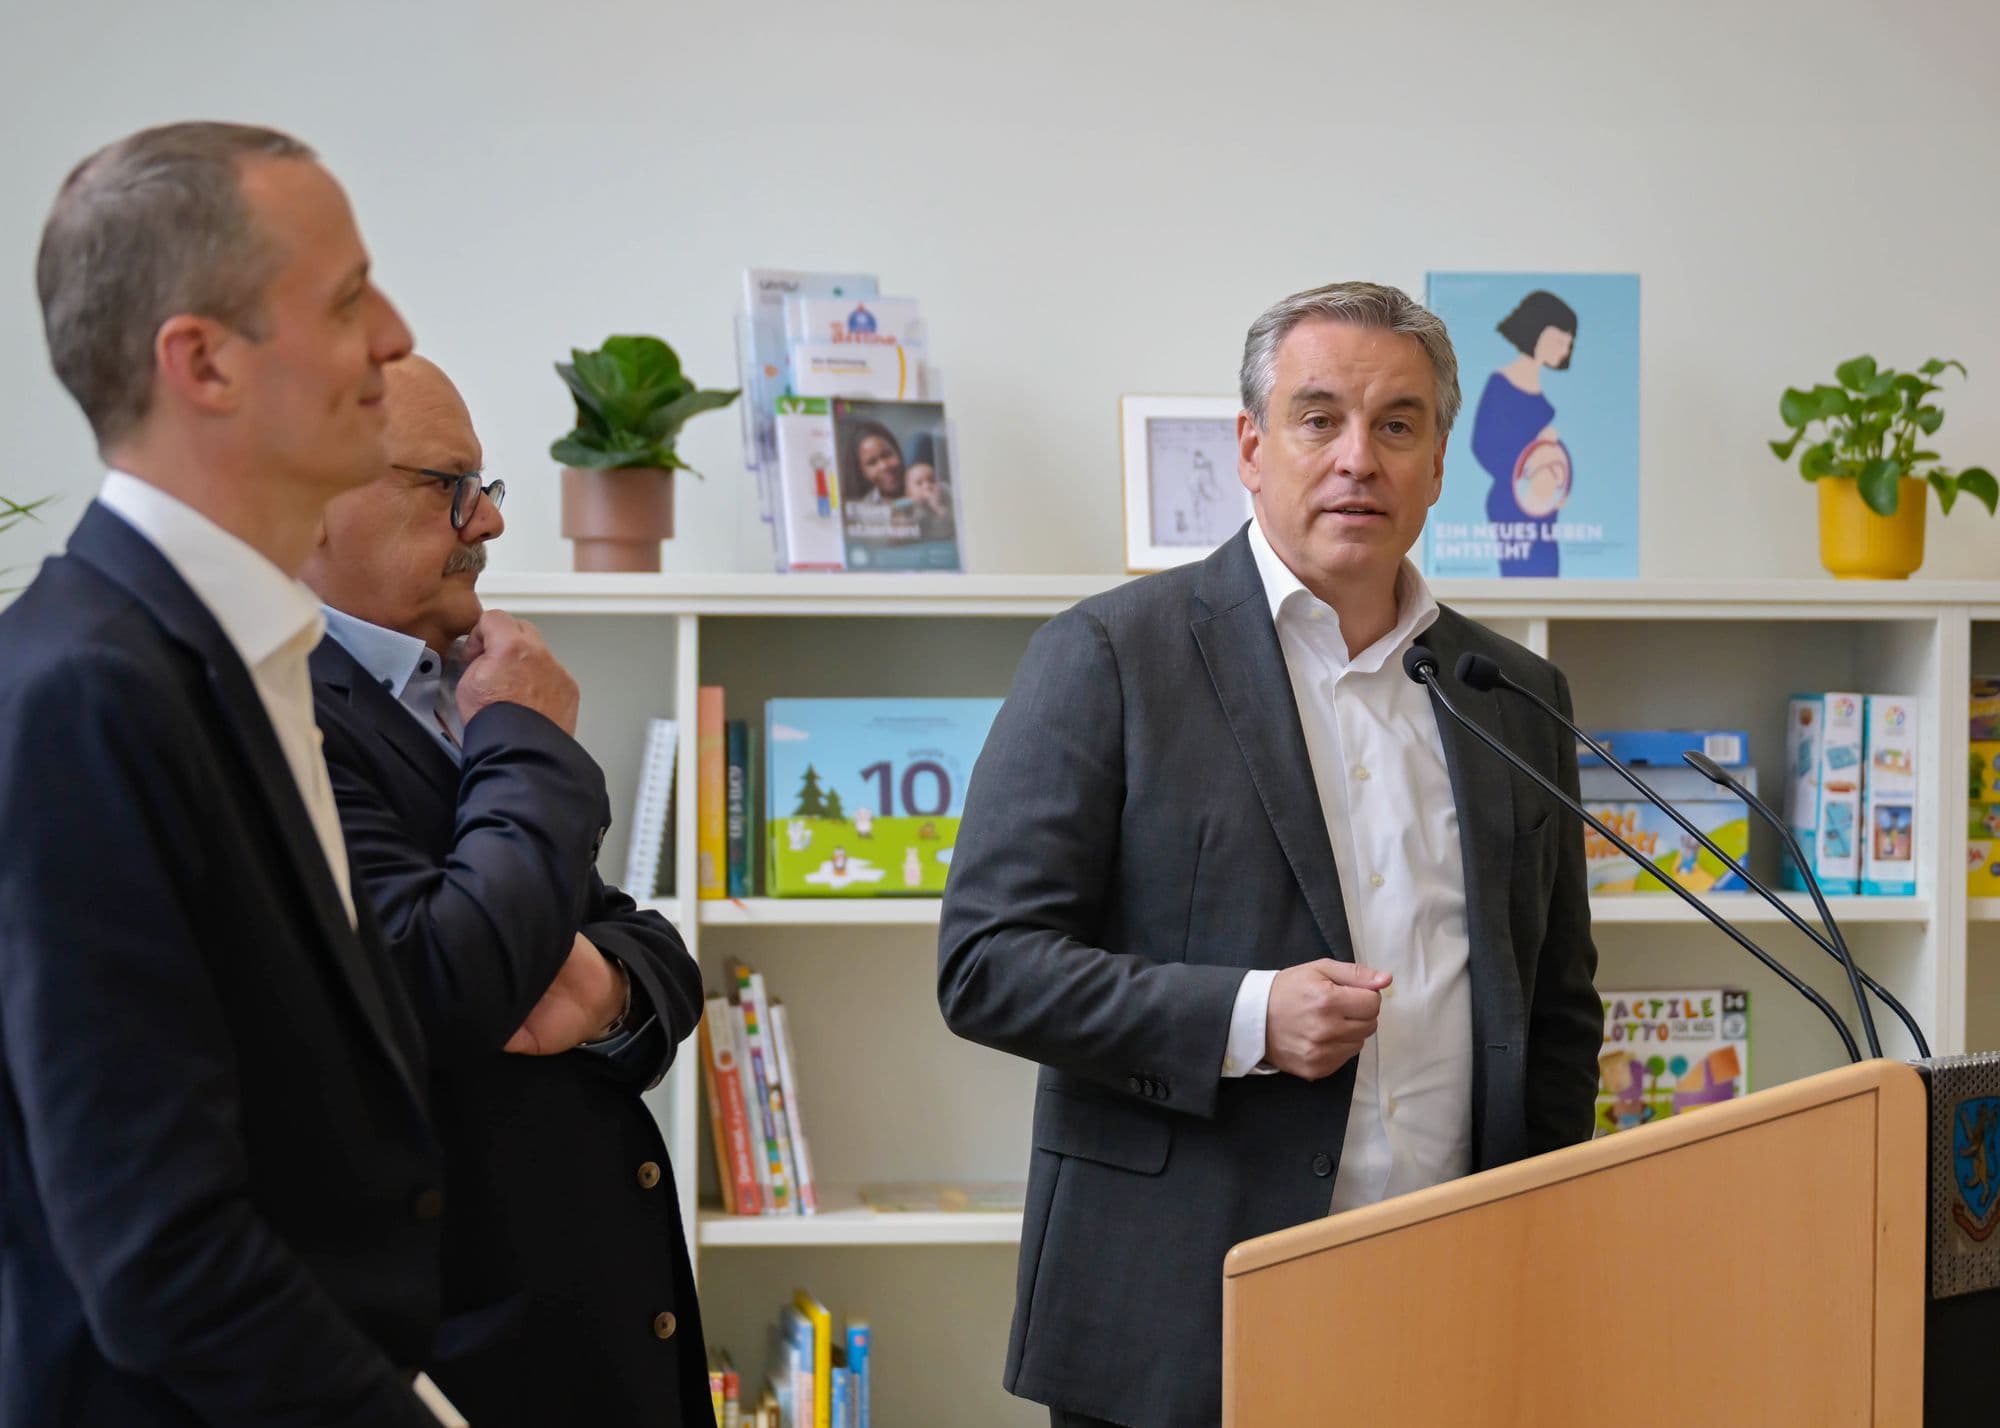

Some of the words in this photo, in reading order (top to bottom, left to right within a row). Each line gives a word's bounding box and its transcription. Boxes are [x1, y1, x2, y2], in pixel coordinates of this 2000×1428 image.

[1434, 523, 1468, 539] EIN
[1472, 522, 1538, 541] NEUES
[1540, 522, 1604, 542] LEBEN
[1434, 541, 1532, 560] ENTSTEHT
[860, 760, 952, 817] 10
[1603, 1022, 1670, 1042] OTTO
